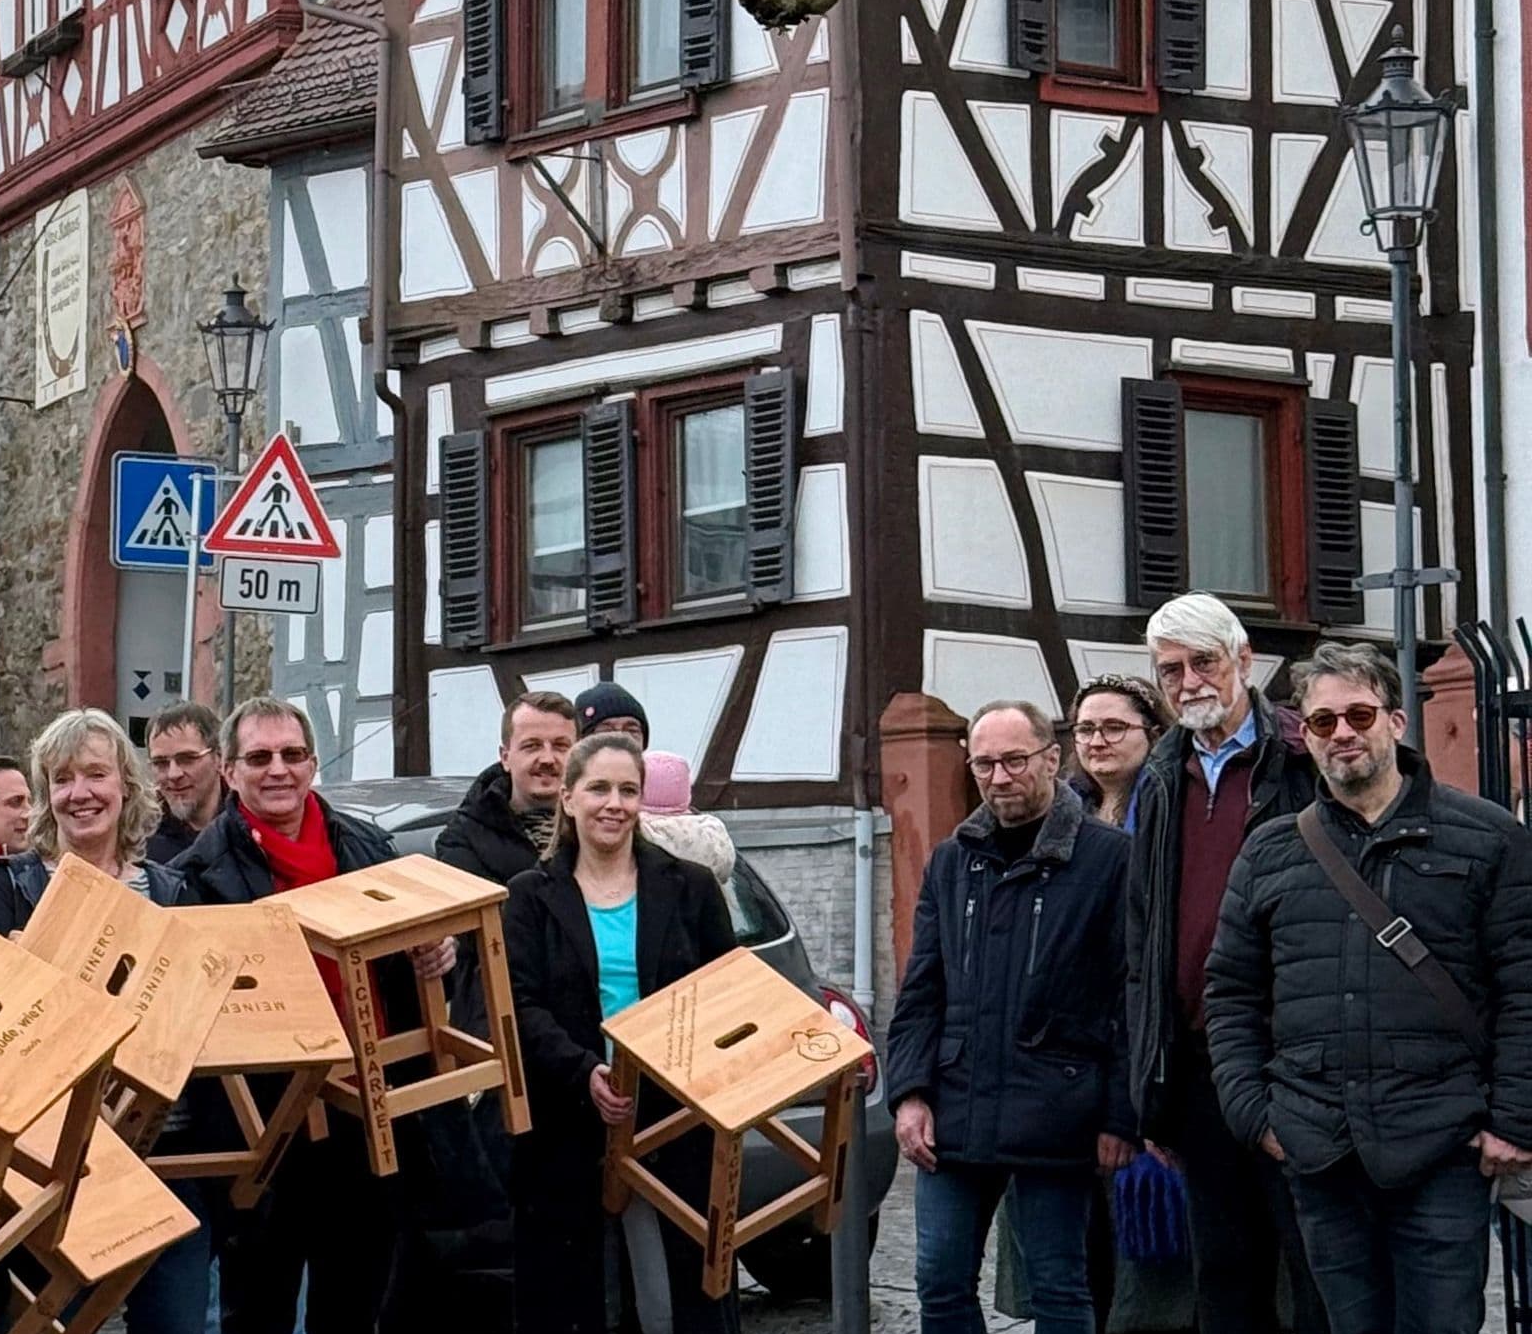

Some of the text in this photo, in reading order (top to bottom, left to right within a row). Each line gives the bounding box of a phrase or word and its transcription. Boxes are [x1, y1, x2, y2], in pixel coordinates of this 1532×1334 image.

[239, 568, 300, 602] 50 m
[79, 936, 111, 984] EINER
[134, 955, 172, 1012] DEINER
[349, 949, 394, 1165] SICHTBARKEIT
